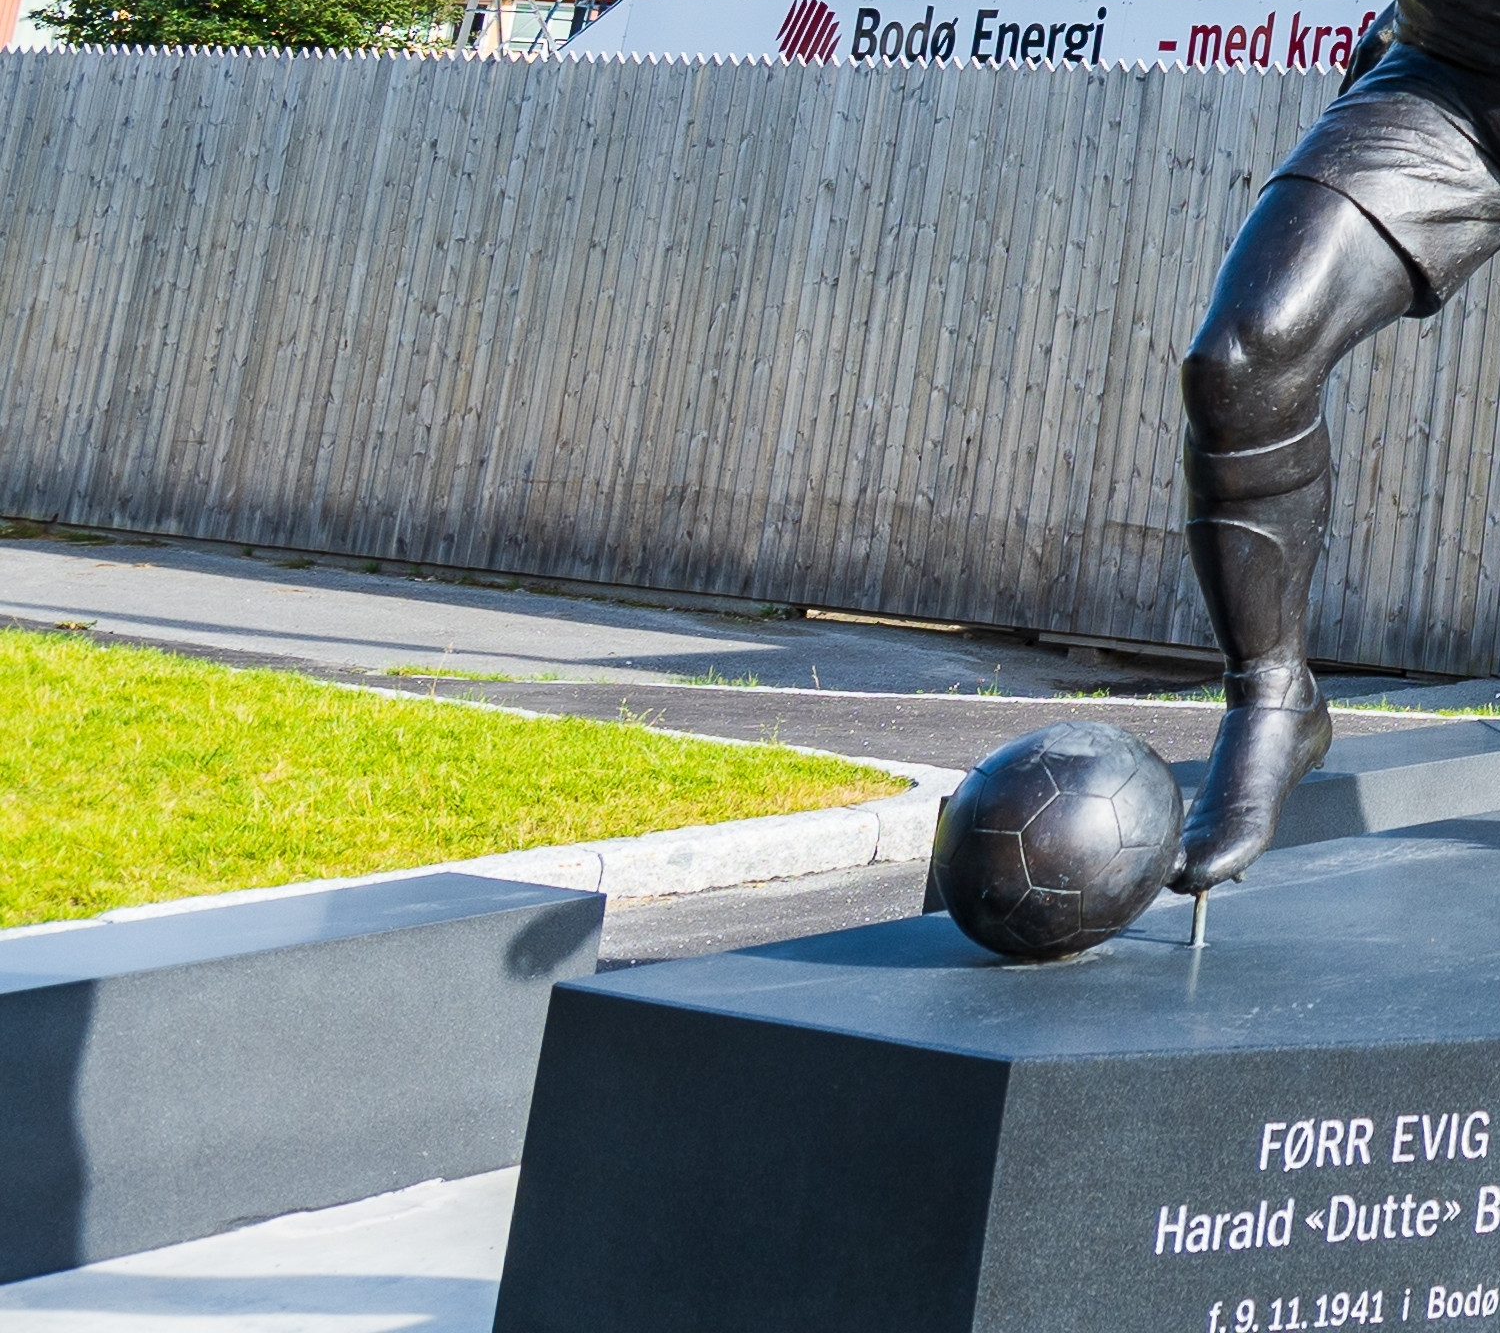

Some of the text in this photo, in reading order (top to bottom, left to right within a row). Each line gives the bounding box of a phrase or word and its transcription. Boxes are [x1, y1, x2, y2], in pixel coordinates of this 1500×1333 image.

[850, 5, 959, 64] Bodø
[970, 6, 1108, 66] Energi
[1187, 10, 1276, 69] med
[1287, 10, 1377, 70] kraf
[1258, 1110, 1491, 1173] FØRR EVIG
[1154, 1198, 1295, 1255] Harald
[1304, 1194, 1462, 1244] «Dutte»
[1402, 1288, 1412, 1321] i
[1427, 1283, 1500, 1320] Bodø
